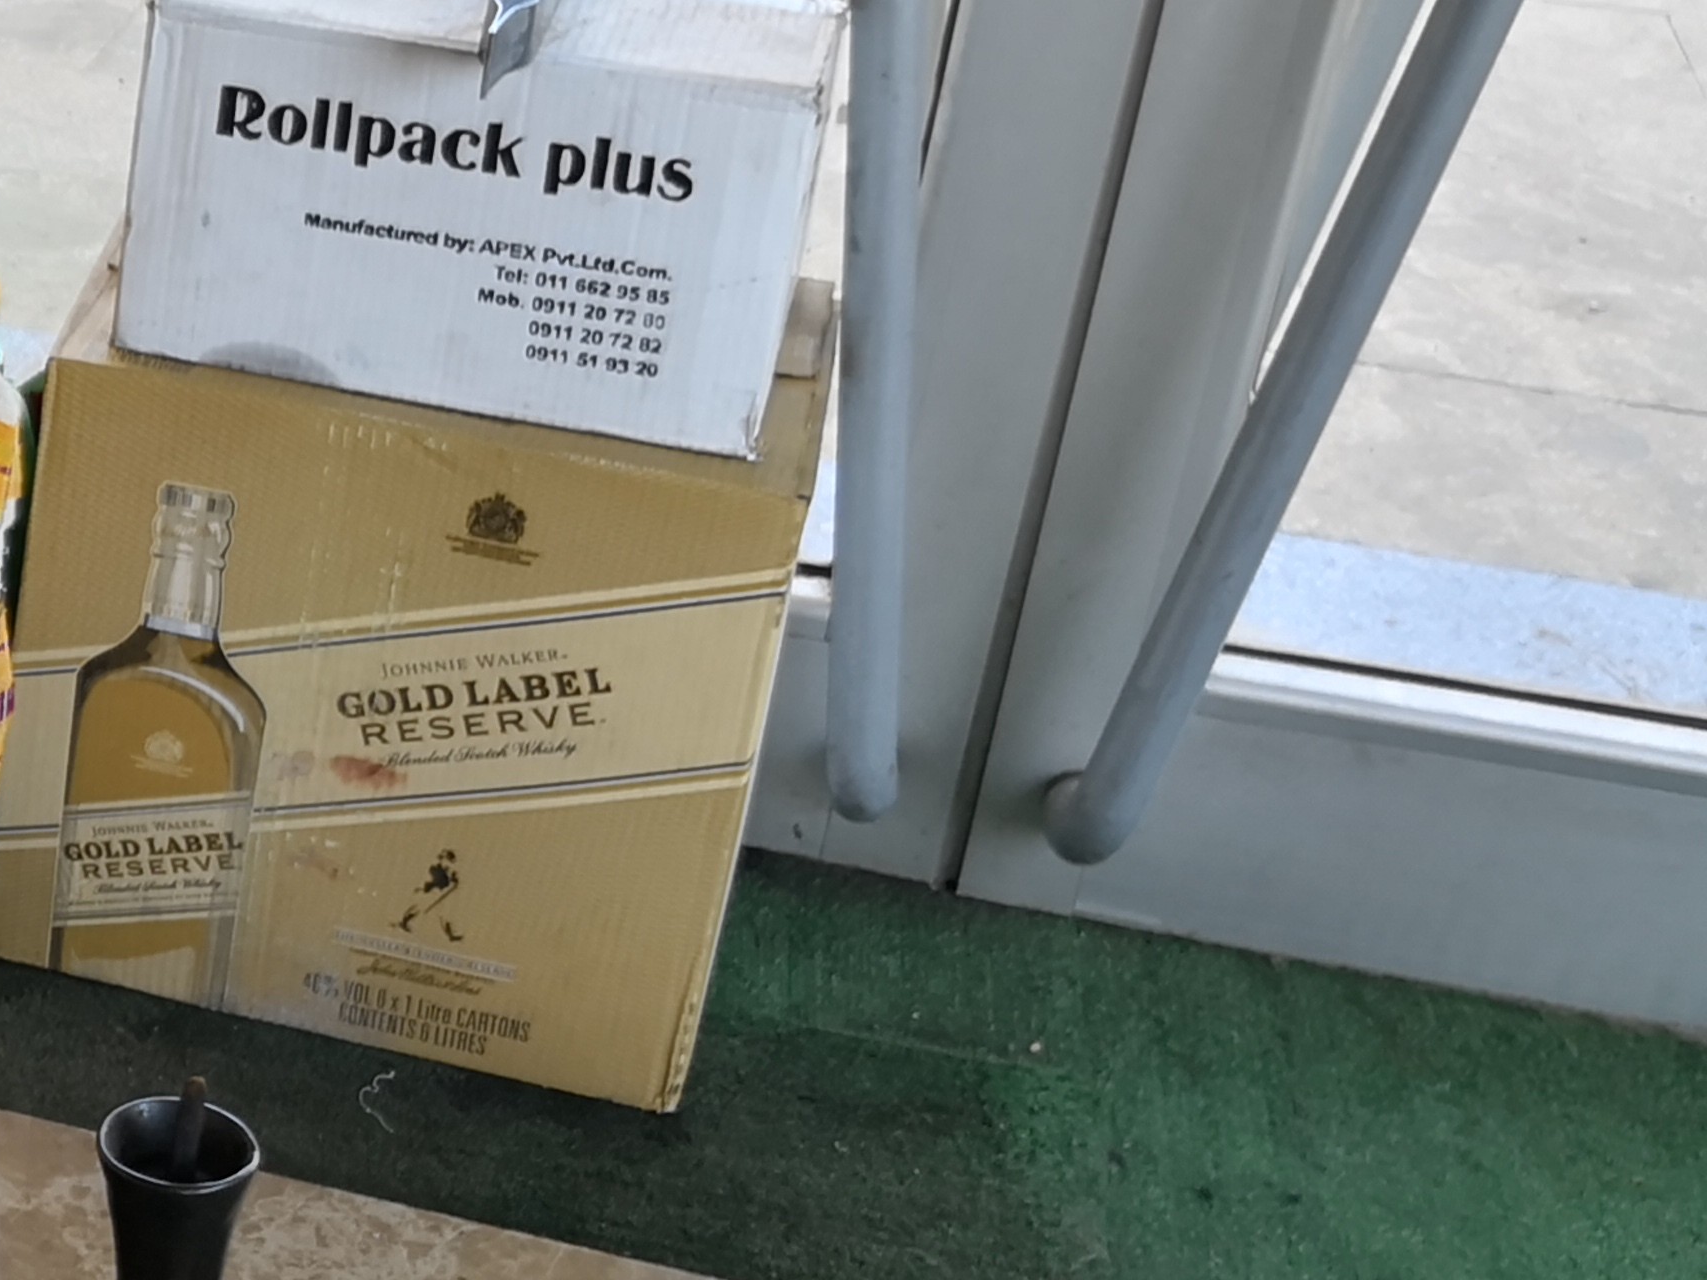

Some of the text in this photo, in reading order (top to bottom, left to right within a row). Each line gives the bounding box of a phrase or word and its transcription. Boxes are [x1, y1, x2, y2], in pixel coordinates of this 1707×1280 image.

[215, 84, 695, 203] Rollpack plus
[304, 212, 438, 246] Manufactured
[443, 232, 475, 253] by:
[478, 238, 536, 261] APEX
[495, 265, 670, 306] Tel: 011 662 95 85
[477, 288, 524, 309] Mob.
[531, 296, 576, 317] 0911
[583, 303, 607, 322] 20
[613, 308, 637, 326] 72
[528, 320, 662, 355] 0911 20 72 82
[525, 345, 658, 379] 0911 51 93 20
[380, 657, 468, 680] JOHNNIE
[337, 667, 612, 719] GOLD LABEL
[360, 701, 596, 746] RESERVE
[384, 746, 451, 769] Blended
[512, 738, 577, 759] Whisky
[64, 831, 244, 862] GOLD LABEL
[82, 853, 235, 879] RESERVE
[339, 1001, 418, 1039] CONTENTS
[434, 1025, 488, 1056] LITRES
[342, 979, 372, 1006] VOL
[417, 998, 452, 1024] Litre
[456, 1007, 531, 1043] CARTONS
